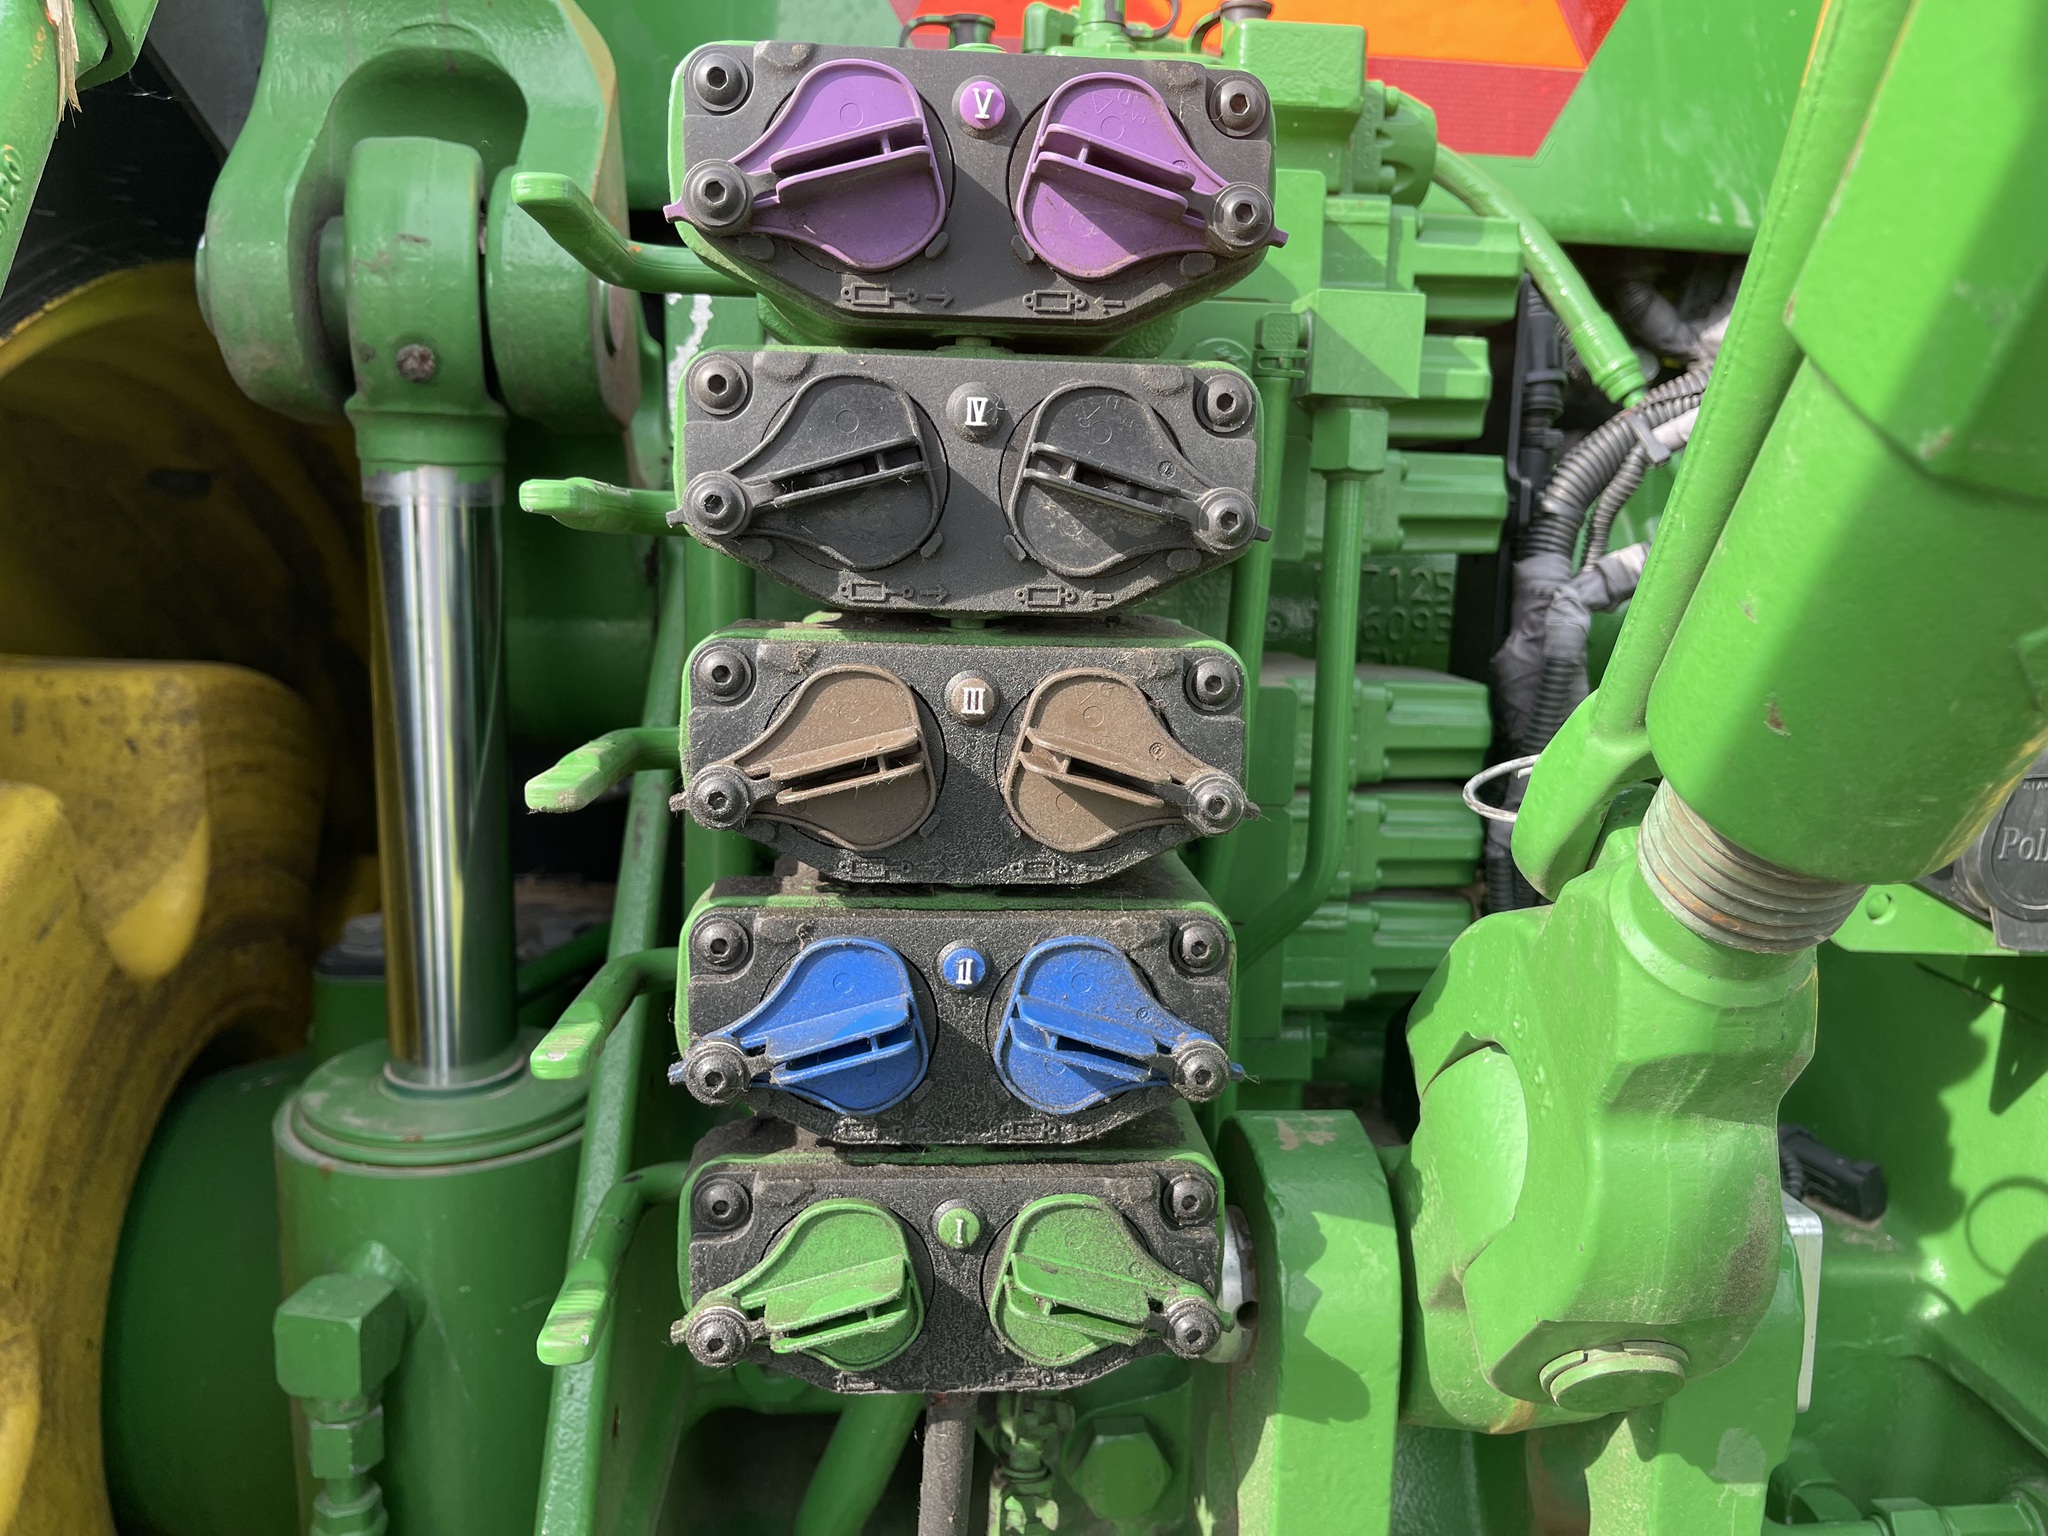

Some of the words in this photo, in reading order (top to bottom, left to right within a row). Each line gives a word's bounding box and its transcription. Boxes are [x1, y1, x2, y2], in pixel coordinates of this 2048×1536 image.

[972, 87, 995, 119] V
[964, 396, 989, 427] IV
[960, 686, 987, 715] III
[1997, 825, 2048, 863] Pol
[955, 957, 974, 986] II
[954, 1217, 965, 1245] I
